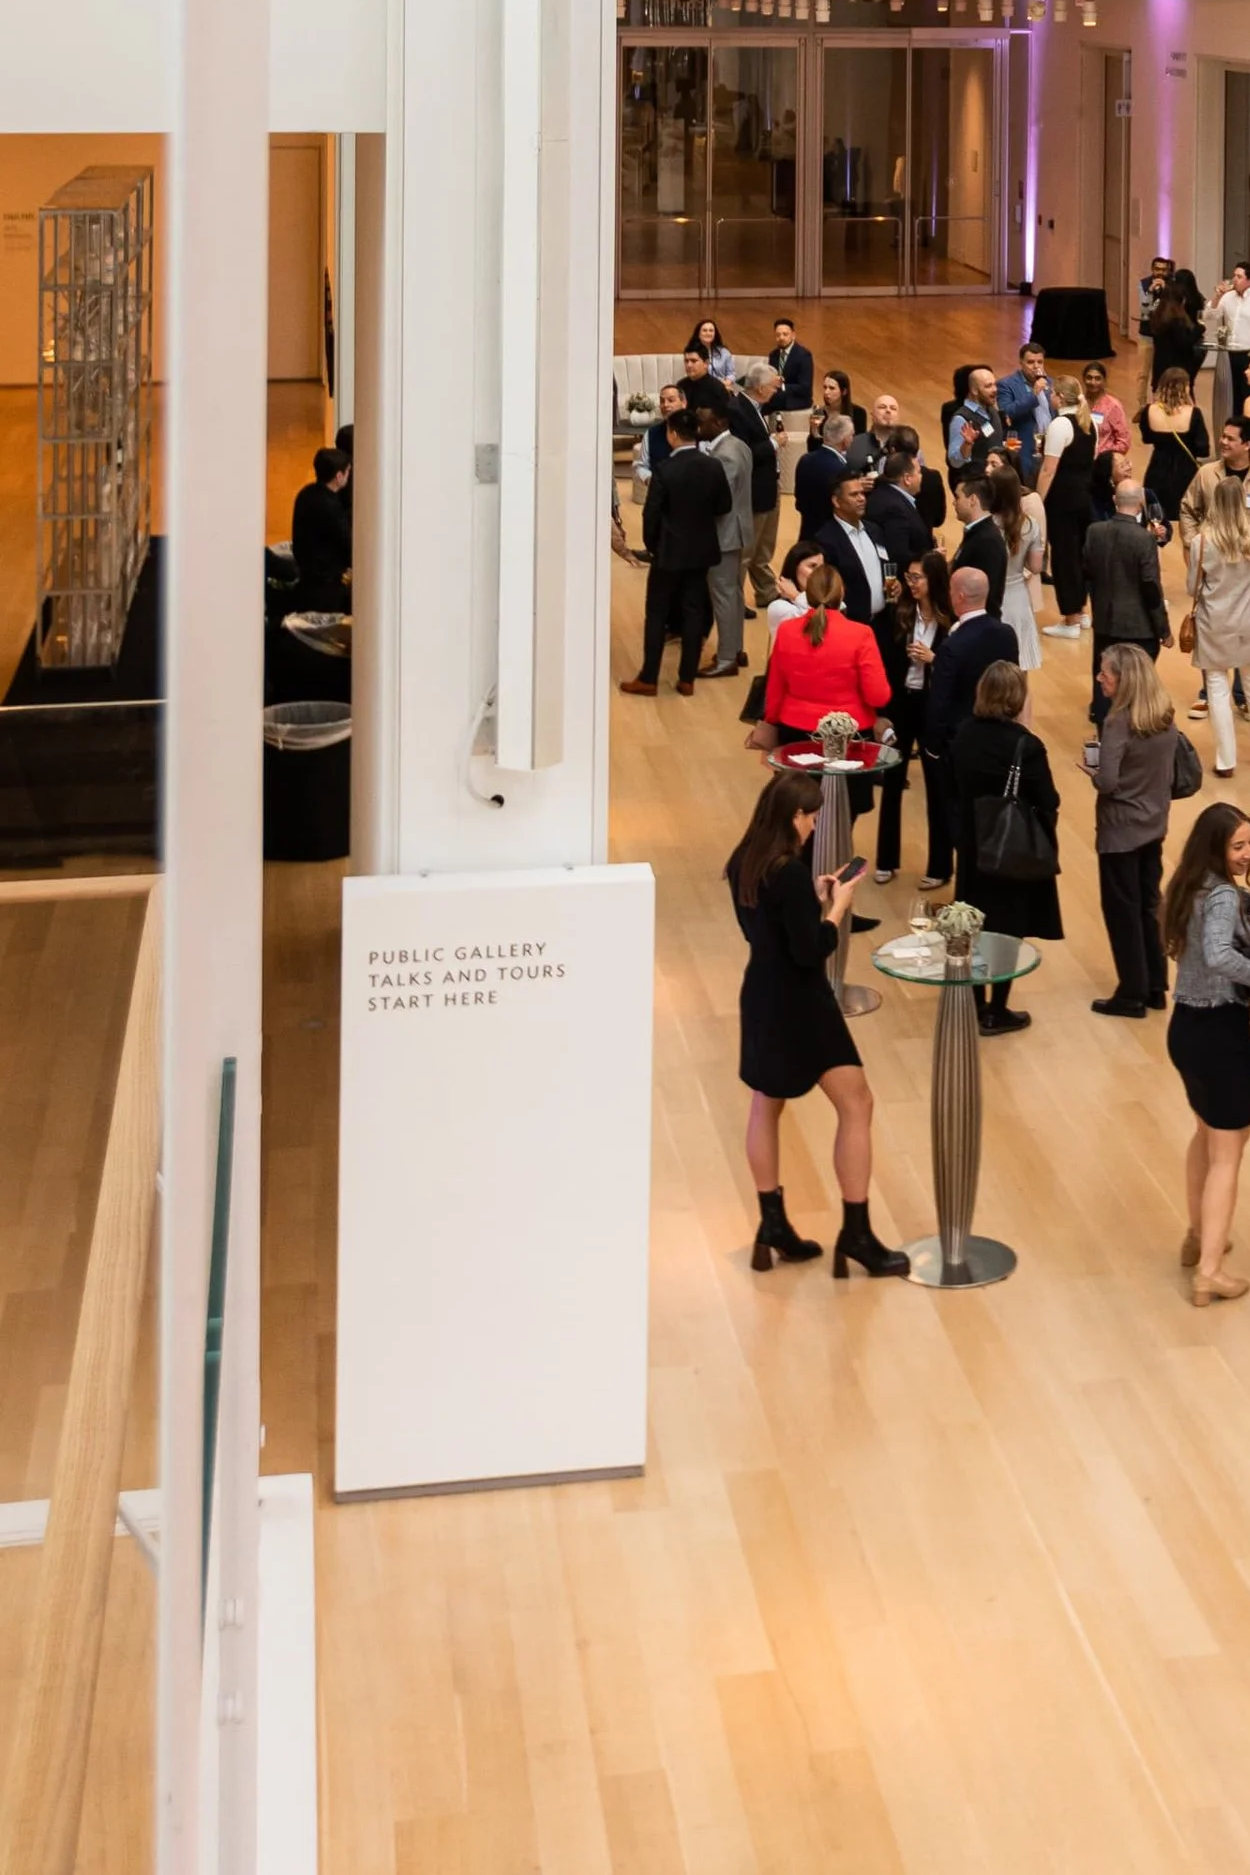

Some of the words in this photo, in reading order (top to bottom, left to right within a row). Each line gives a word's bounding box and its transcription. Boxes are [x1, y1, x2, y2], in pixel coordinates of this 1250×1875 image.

[368, 947, 445, 966] PUBLIC
[454, 942, 547, 961] GALLERY
[368, 971, 433, 988] TALKS
[442, 968, 488, 985] AND
[497, 963, 566, 981] TOURS
[368, 994, 434, 1012] START
[444, 990, 499, 1007] HERE
